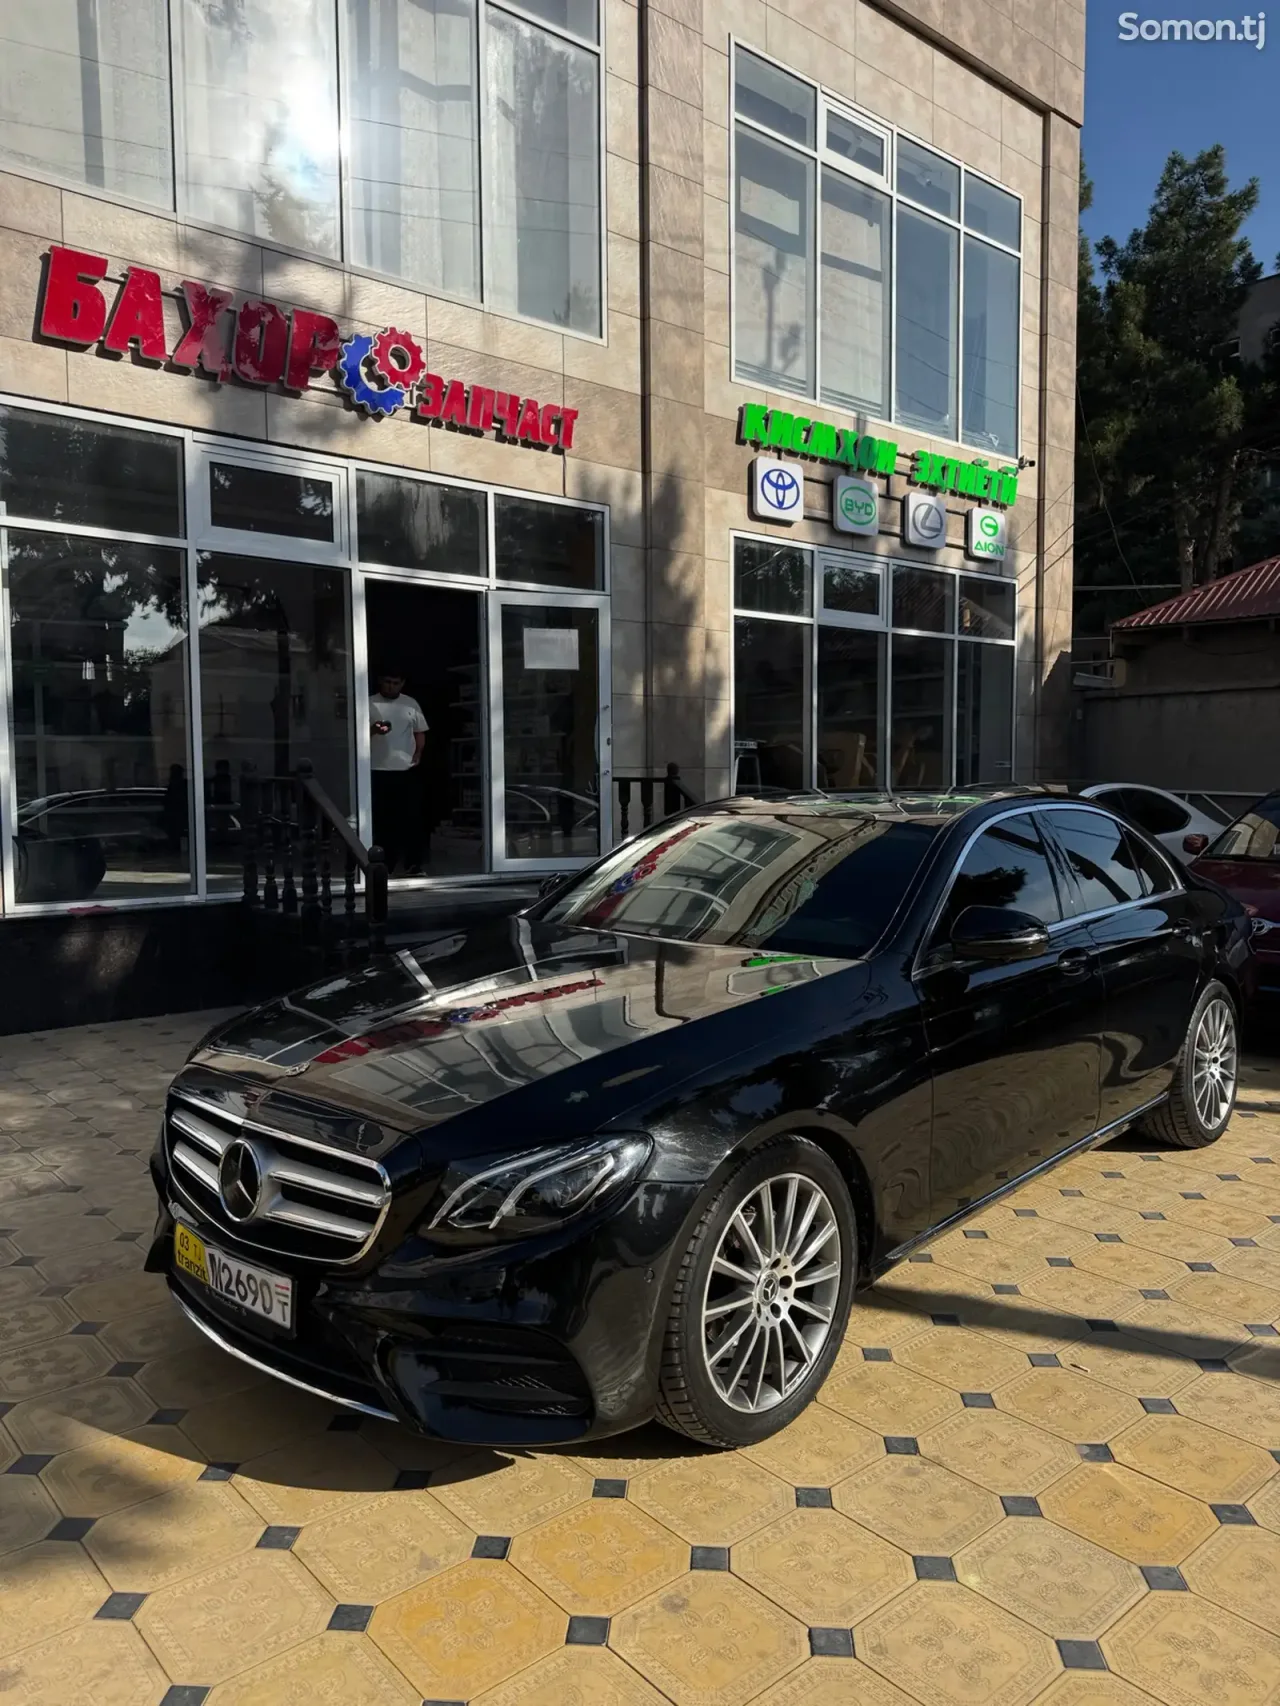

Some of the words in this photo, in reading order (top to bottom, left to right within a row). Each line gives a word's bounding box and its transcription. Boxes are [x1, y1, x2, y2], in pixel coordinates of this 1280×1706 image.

[416, 373, 579, 449] ЗАПЧАСТ
[844, 497, 874, 515] BYD
[974, 539, 1005, 556] AION
[179, 1232, 190, 1252] 03
[177, 1250, 208, 1283] tranzit
